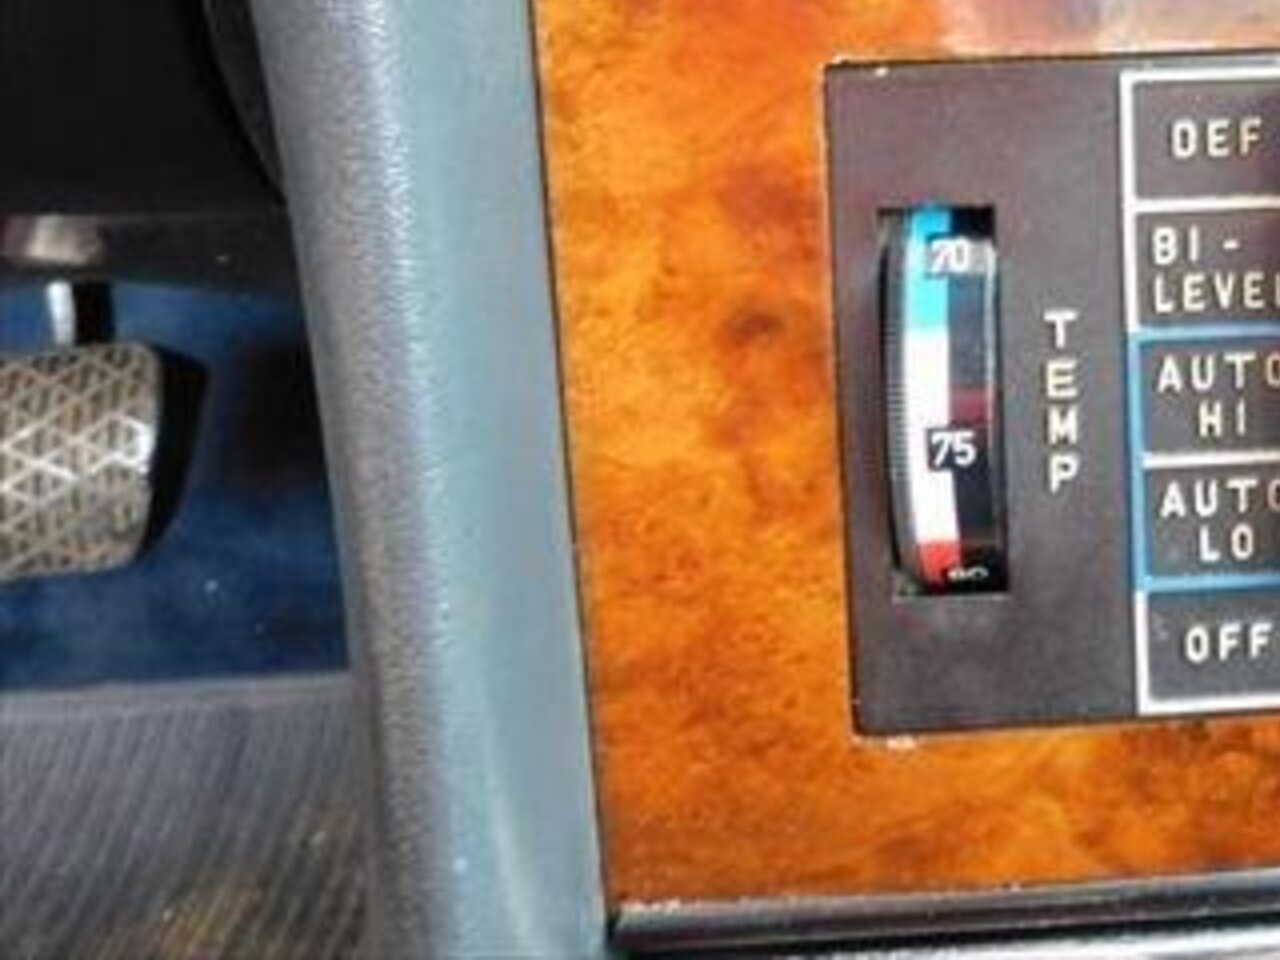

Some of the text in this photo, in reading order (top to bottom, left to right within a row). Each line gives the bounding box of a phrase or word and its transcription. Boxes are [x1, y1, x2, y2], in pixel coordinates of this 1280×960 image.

[1170, 116, 1263, 158] DEF
[928, 238, 972, 274] 70
[1043, 309, 1080, 493] TEMP
[1199, 401, 1248, 437] HI
[931, 430, 977, 467] 75
[1199, 523, 1256, 562] LO
[1184, 622, 1274, 664] OFF
